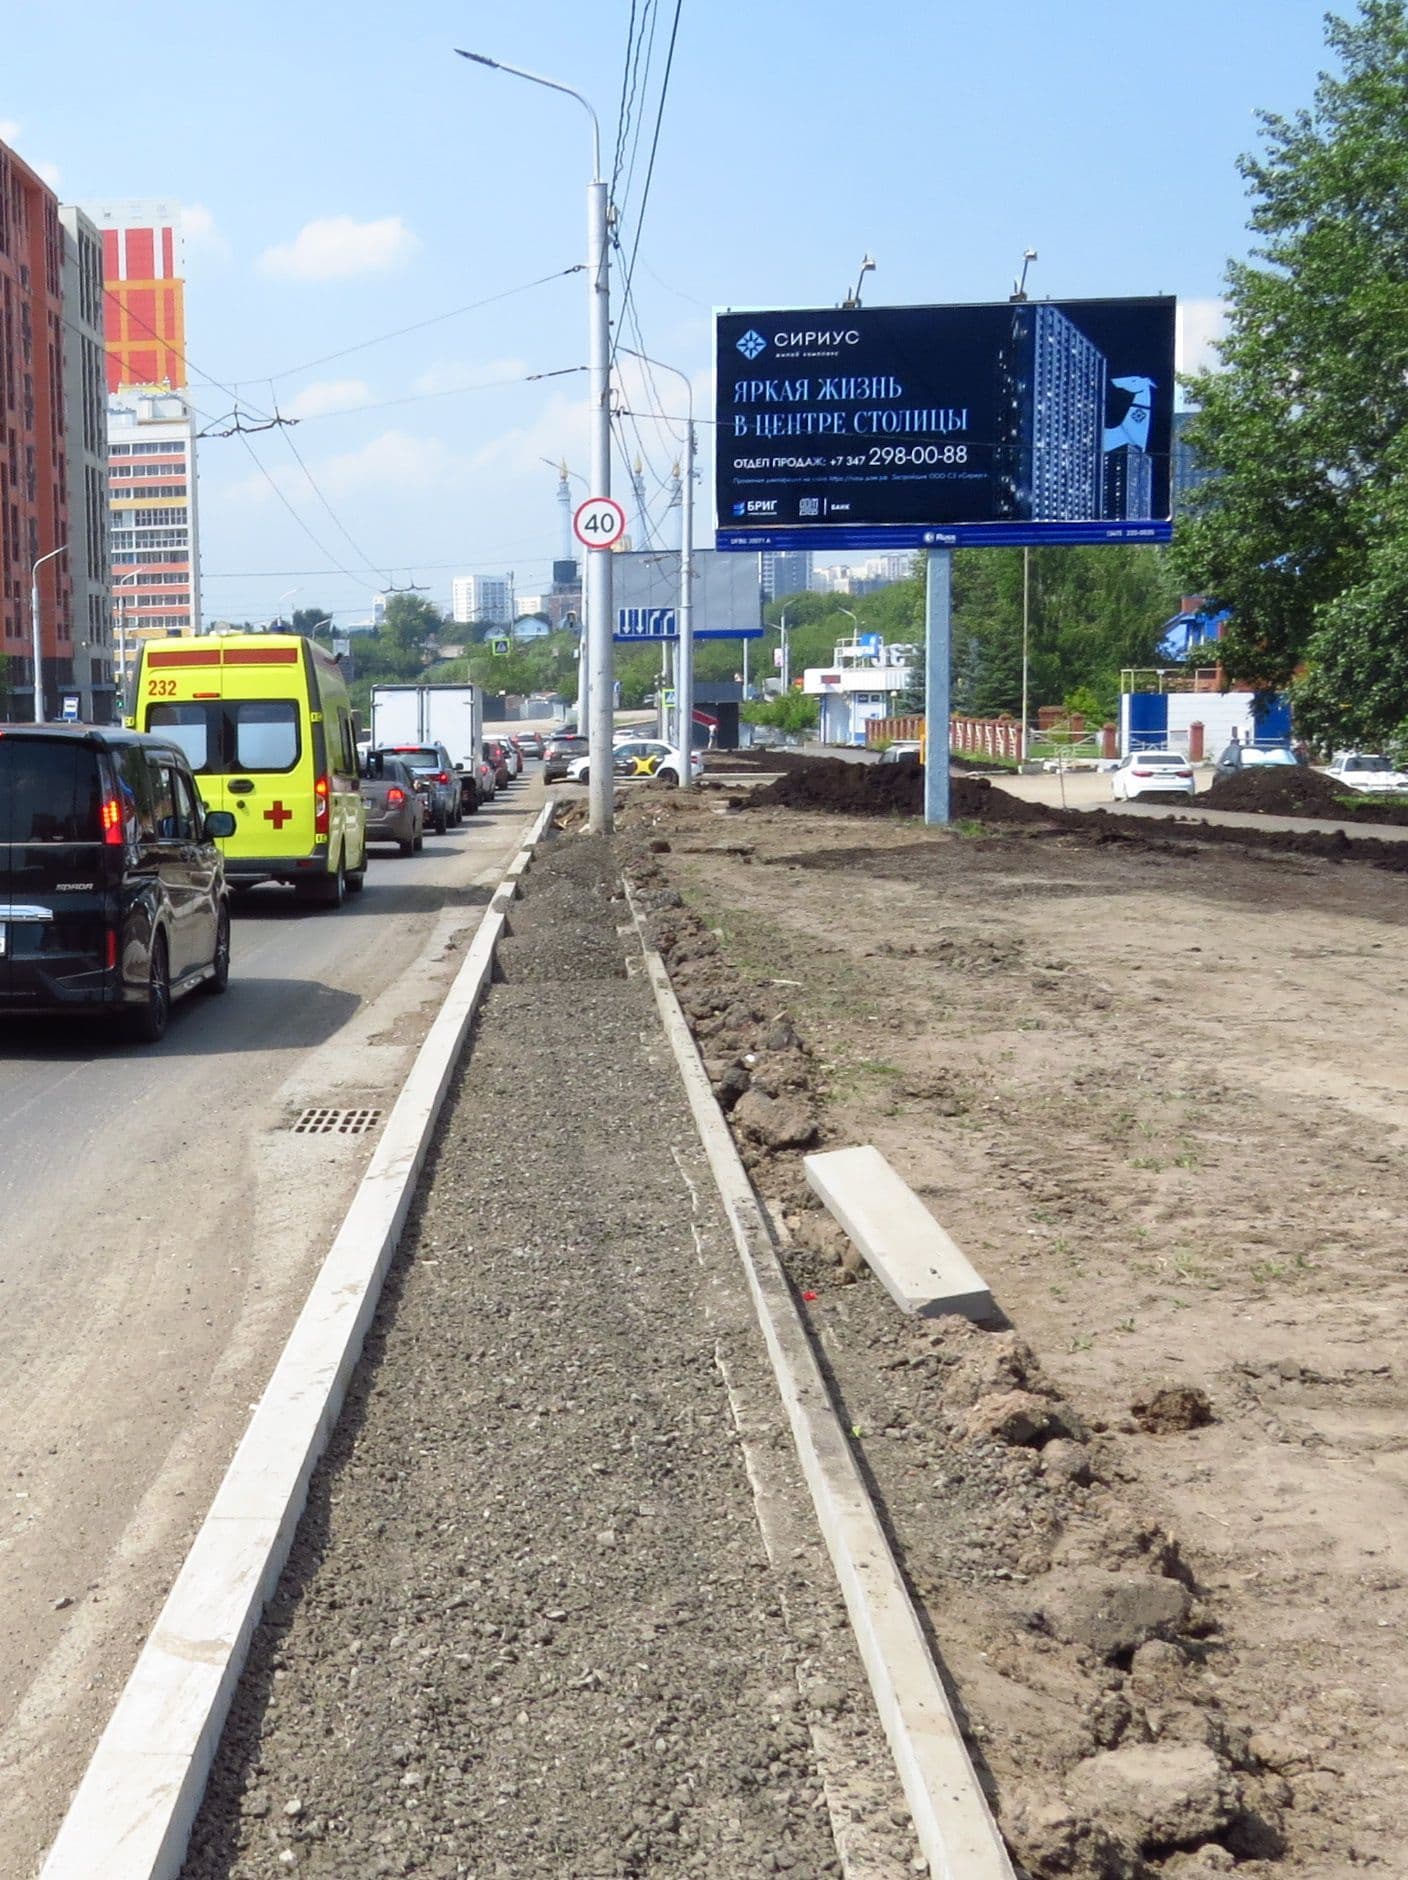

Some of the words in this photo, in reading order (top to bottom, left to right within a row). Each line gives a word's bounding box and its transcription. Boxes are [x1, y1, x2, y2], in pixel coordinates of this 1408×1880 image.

[774, 330, 860, 347] СИРИУС
[733, 378, 809, 403] ЯРКАЯ
[816, 376, 903, 401] ЖИЗНЬ
[734, 414, 748, 437] В
[755, 412, 846, 439] ЦЕНТРЕ
[853, 408, 969, 435] СТОЛИЦЫ
[733, 457, 770, 469] ОТДЕЛ
[772, 456, 826, 468] ПРОДАЖ:
[830, 456, 844, 466] +7
[846, 455, 866, 466] 347
[868, 445, 968, 466] 298-00-88
[747, 500, 777, 511] БРИГ
[583, 513, 615, 533] 40
[148, 680, 177, 696] 232
